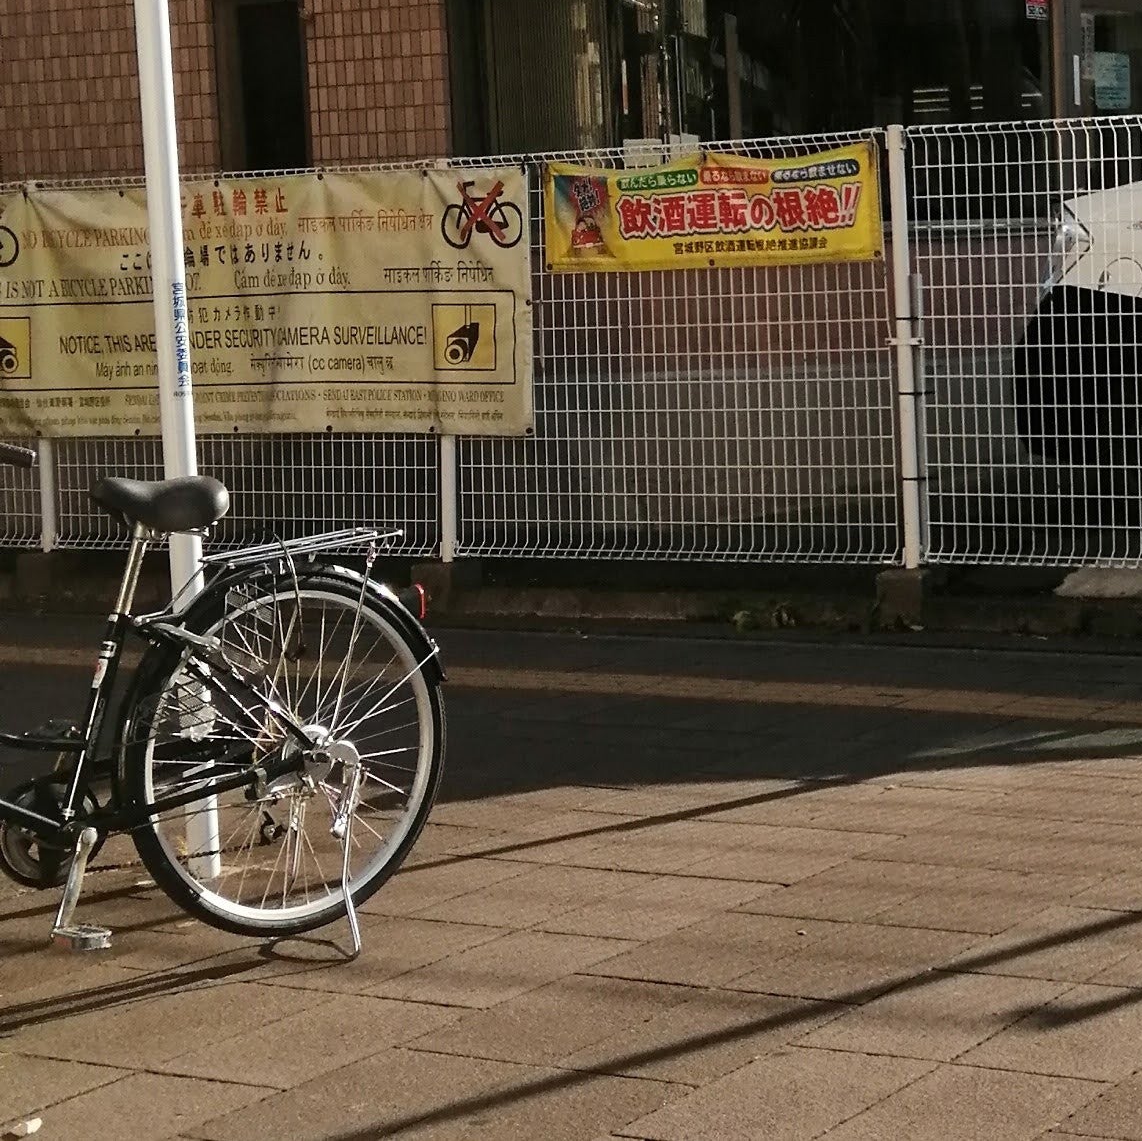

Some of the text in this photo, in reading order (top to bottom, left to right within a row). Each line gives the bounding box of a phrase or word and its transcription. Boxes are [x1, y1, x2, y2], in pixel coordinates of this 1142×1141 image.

[6, 280, 18, 299] IS
[105, 334, 132, 354] THIS
[189, 329, 222, 349] NDER
[225, 327, 276, 348] SECURITY
[333, 325, 427, 345] SURVEILLANCE!
